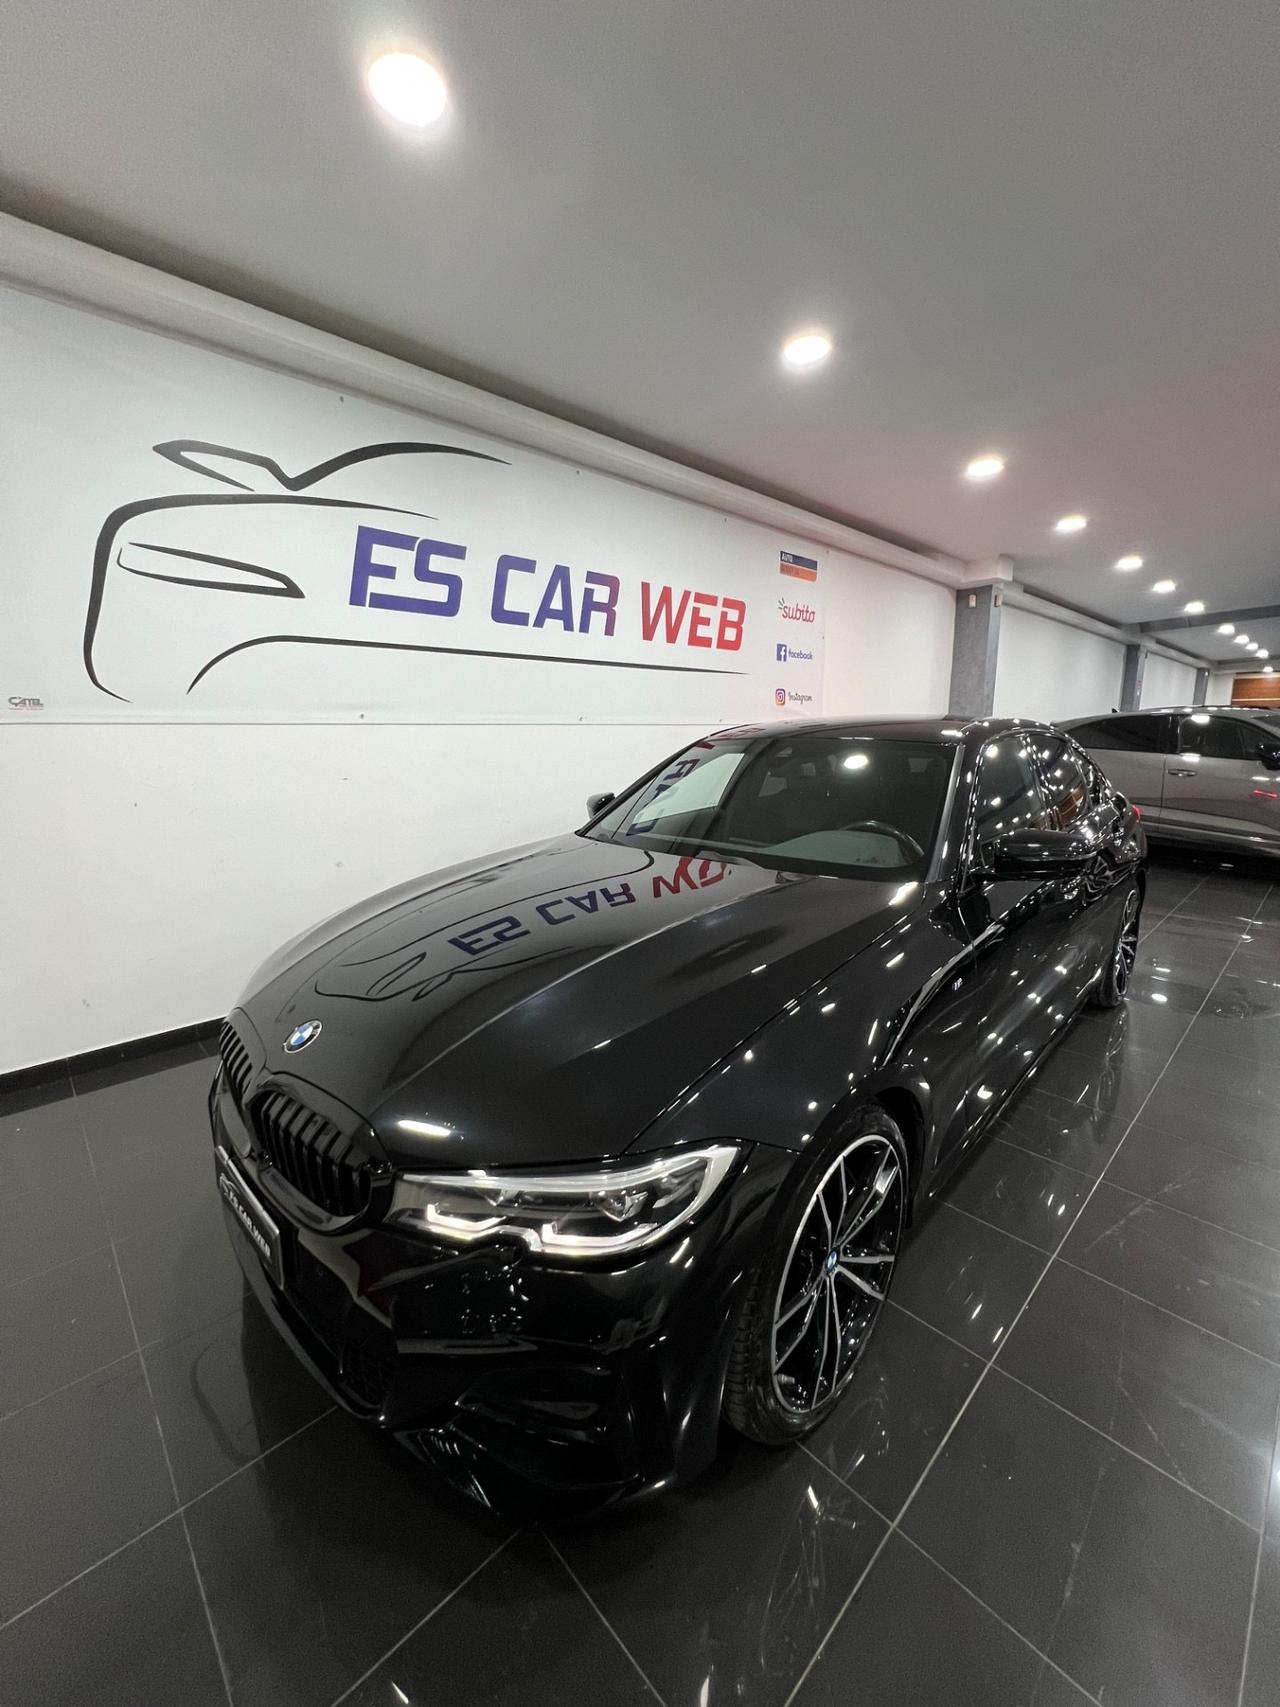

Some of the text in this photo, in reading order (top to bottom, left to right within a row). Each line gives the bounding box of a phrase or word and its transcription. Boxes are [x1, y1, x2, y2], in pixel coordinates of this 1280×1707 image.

[348, 525, 747, 652] ES CAR WEB
[782, 603, 816, 624] subito
[788, 648, 813, 660] facebook
